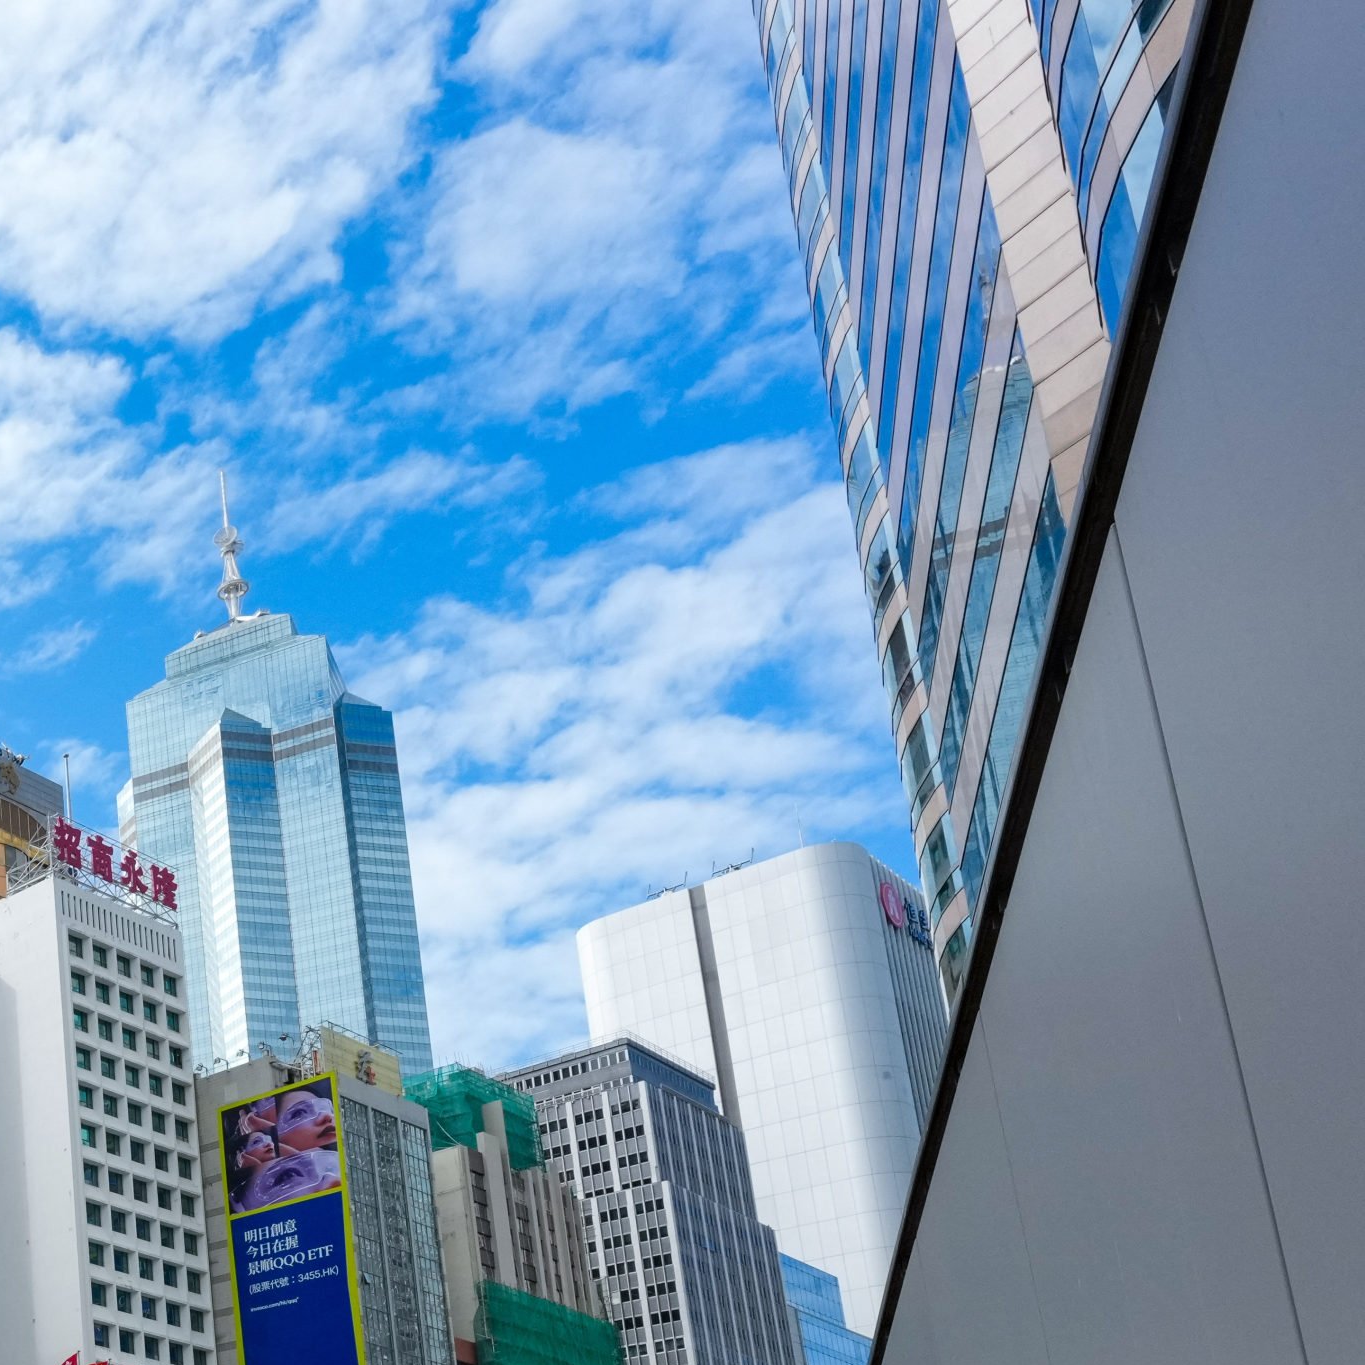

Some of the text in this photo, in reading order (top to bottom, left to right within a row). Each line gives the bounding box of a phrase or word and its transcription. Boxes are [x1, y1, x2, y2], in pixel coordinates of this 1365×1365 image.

[54, 816, 178, 911] 招商永隆
[244, 1219, 297, 1243] 明日創意
[246, 1235, 299, 1258] 今日在握
[307, 1244, 334, 1261] ETF
